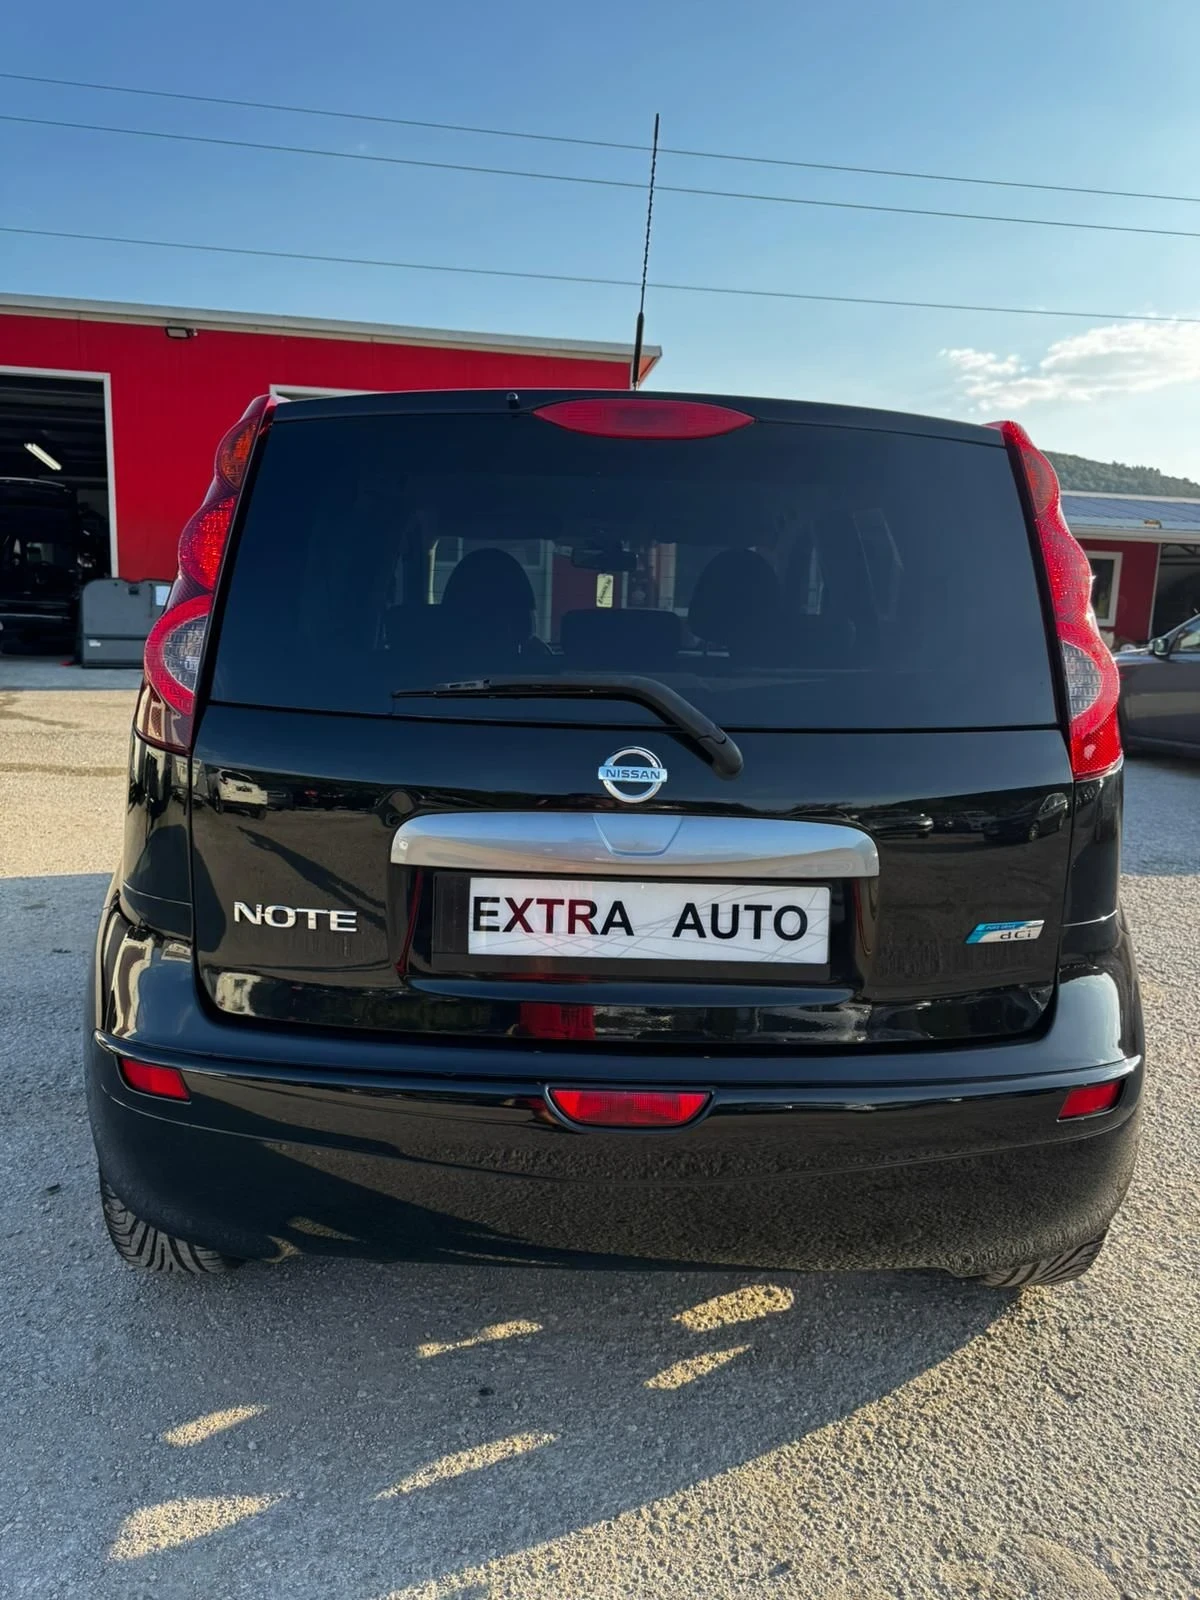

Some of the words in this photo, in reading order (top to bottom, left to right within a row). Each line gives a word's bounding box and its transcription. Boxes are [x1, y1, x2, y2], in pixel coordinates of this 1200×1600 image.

[606, 769, 660, 780] NISSAN
[234, 901, 357, 932] NOTE
[473, 896, 635, 936] EXTRA
[672, 902, 808, 941] AUTO
